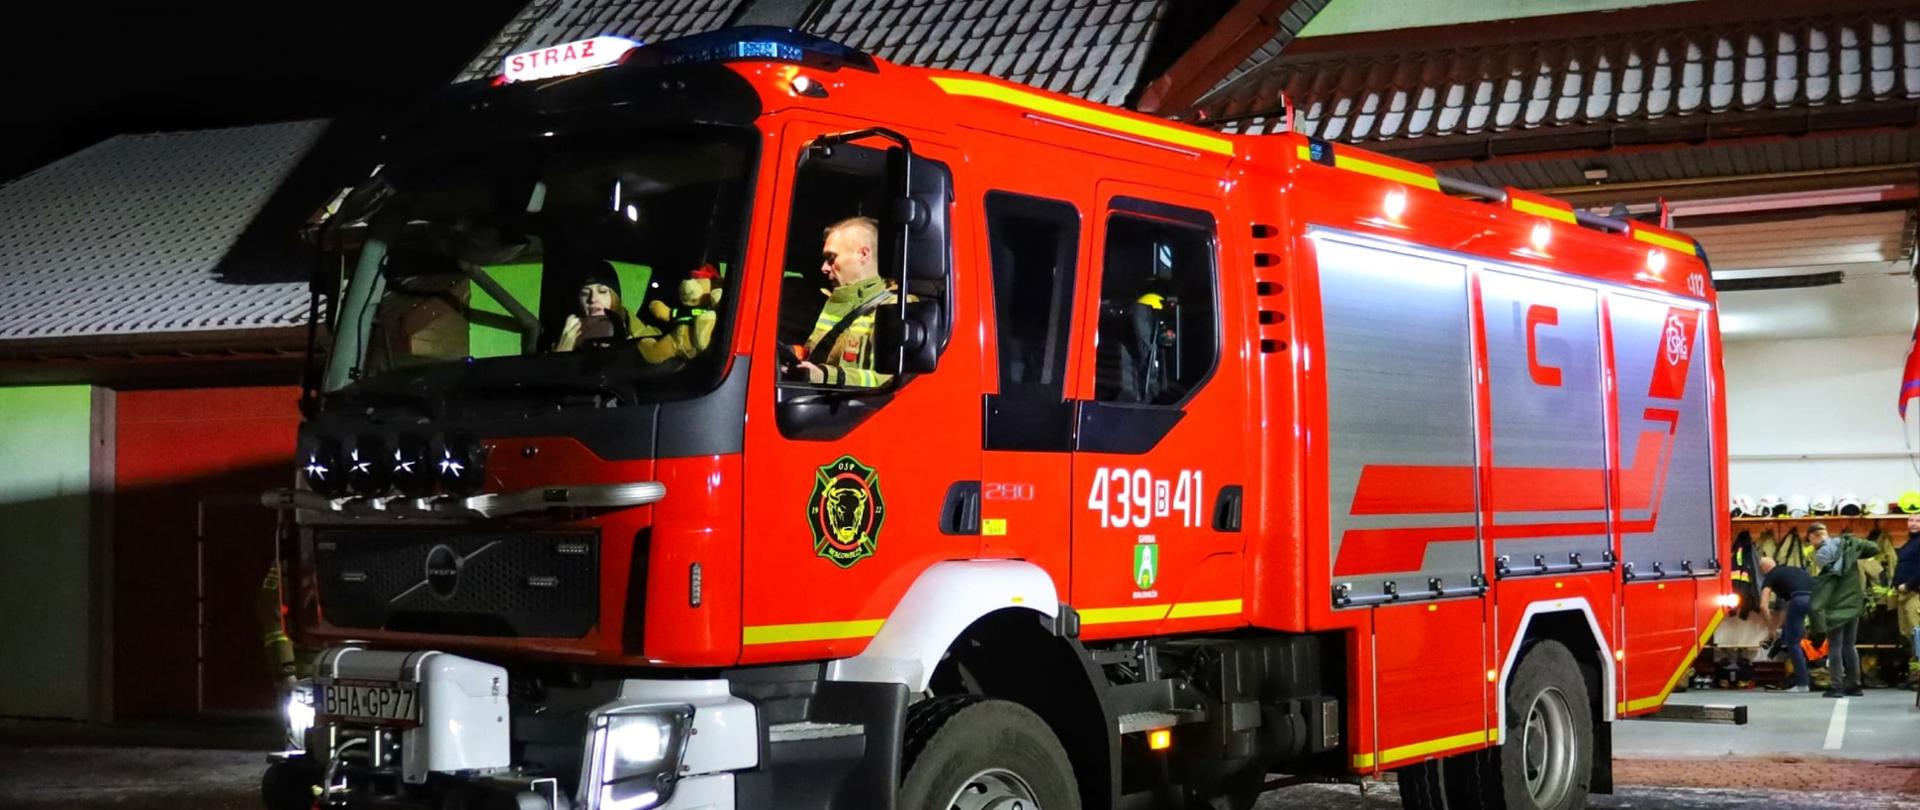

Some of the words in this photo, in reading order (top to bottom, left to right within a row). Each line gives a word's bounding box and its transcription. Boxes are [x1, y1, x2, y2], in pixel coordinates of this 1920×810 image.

[838, 462, 855, 471] OSP
[985, 483, 1034, 501] 280
[326, 687, 360, 716] BHA
[367, 689, 413, 718] GP77
